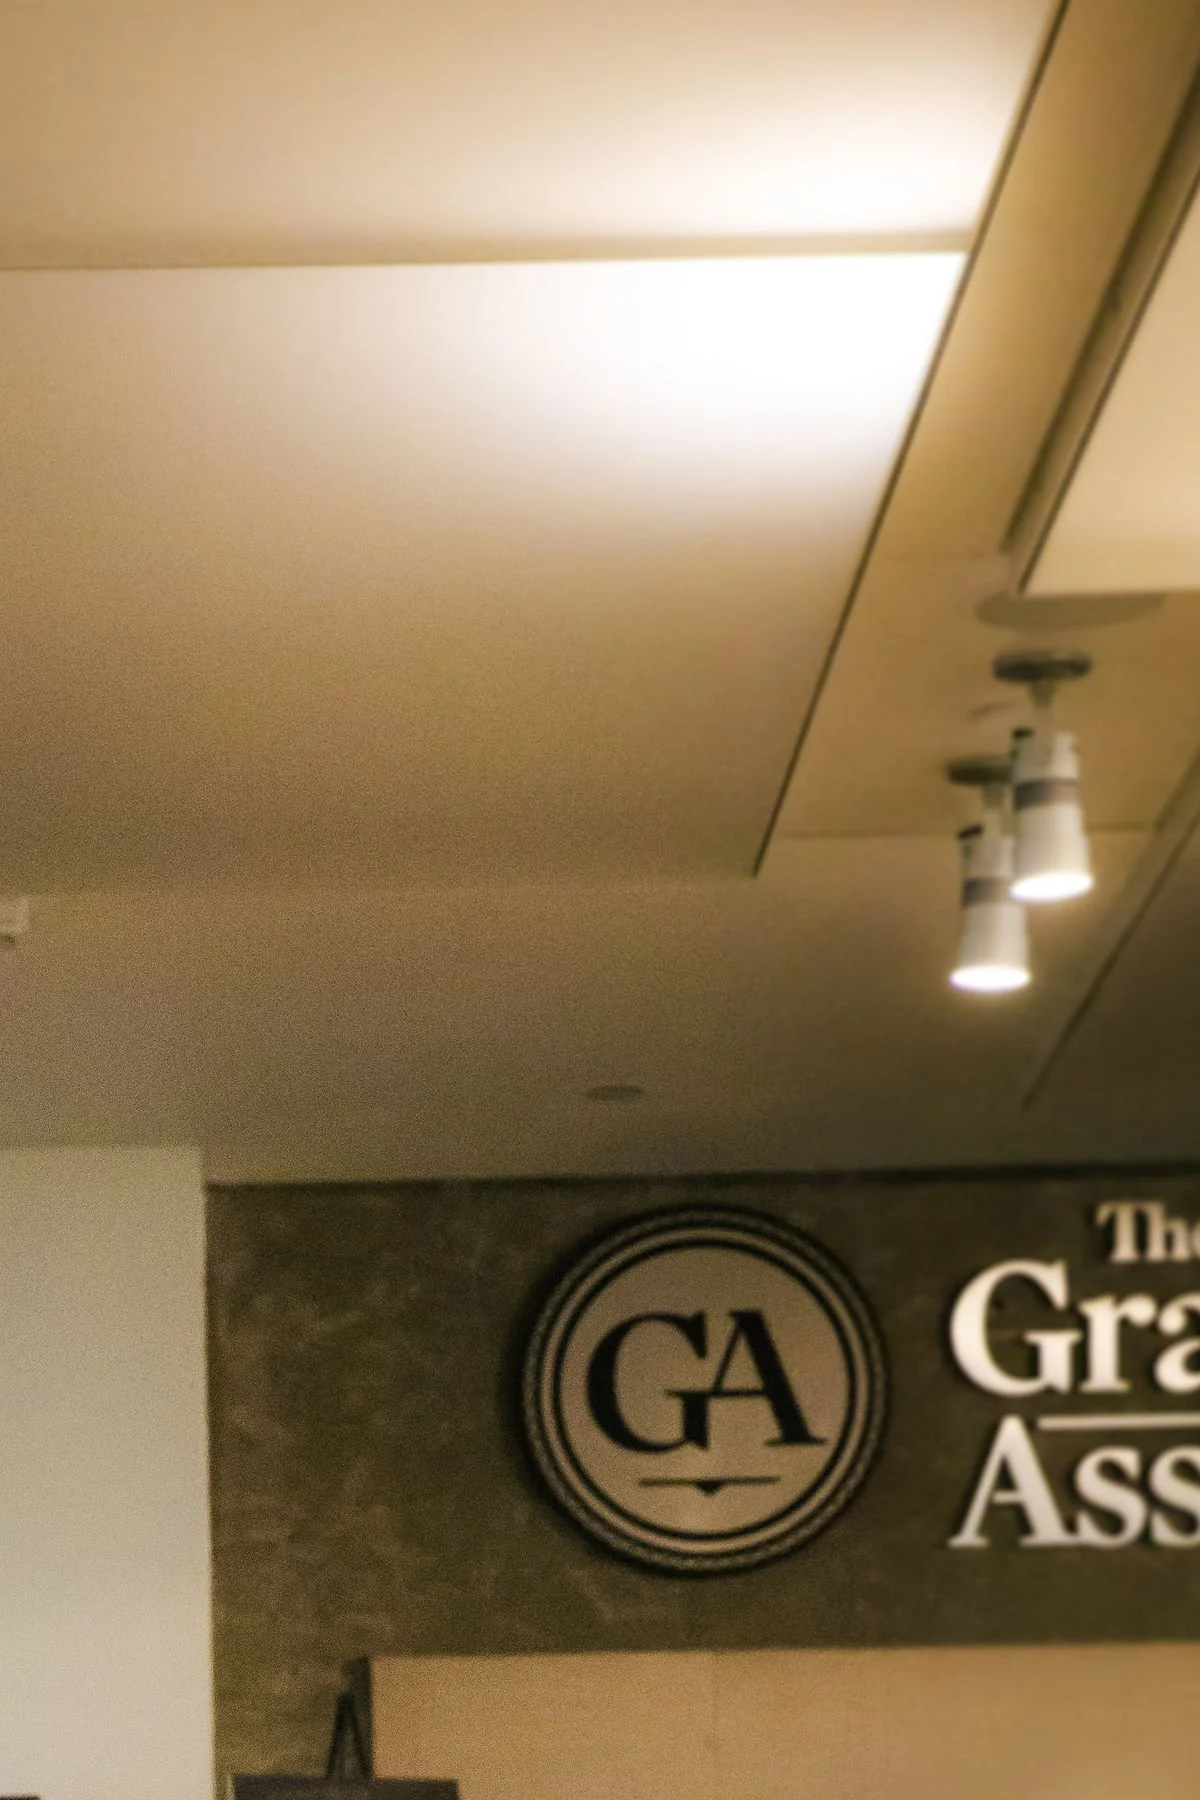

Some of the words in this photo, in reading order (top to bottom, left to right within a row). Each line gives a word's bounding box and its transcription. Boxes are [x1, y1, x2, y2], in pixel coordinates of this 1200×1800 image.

[585, 1307, 828, 1456] GA
[950, 1258, 1200, 1397] Gra
[947, 1413, 1200, 1548] Ass
